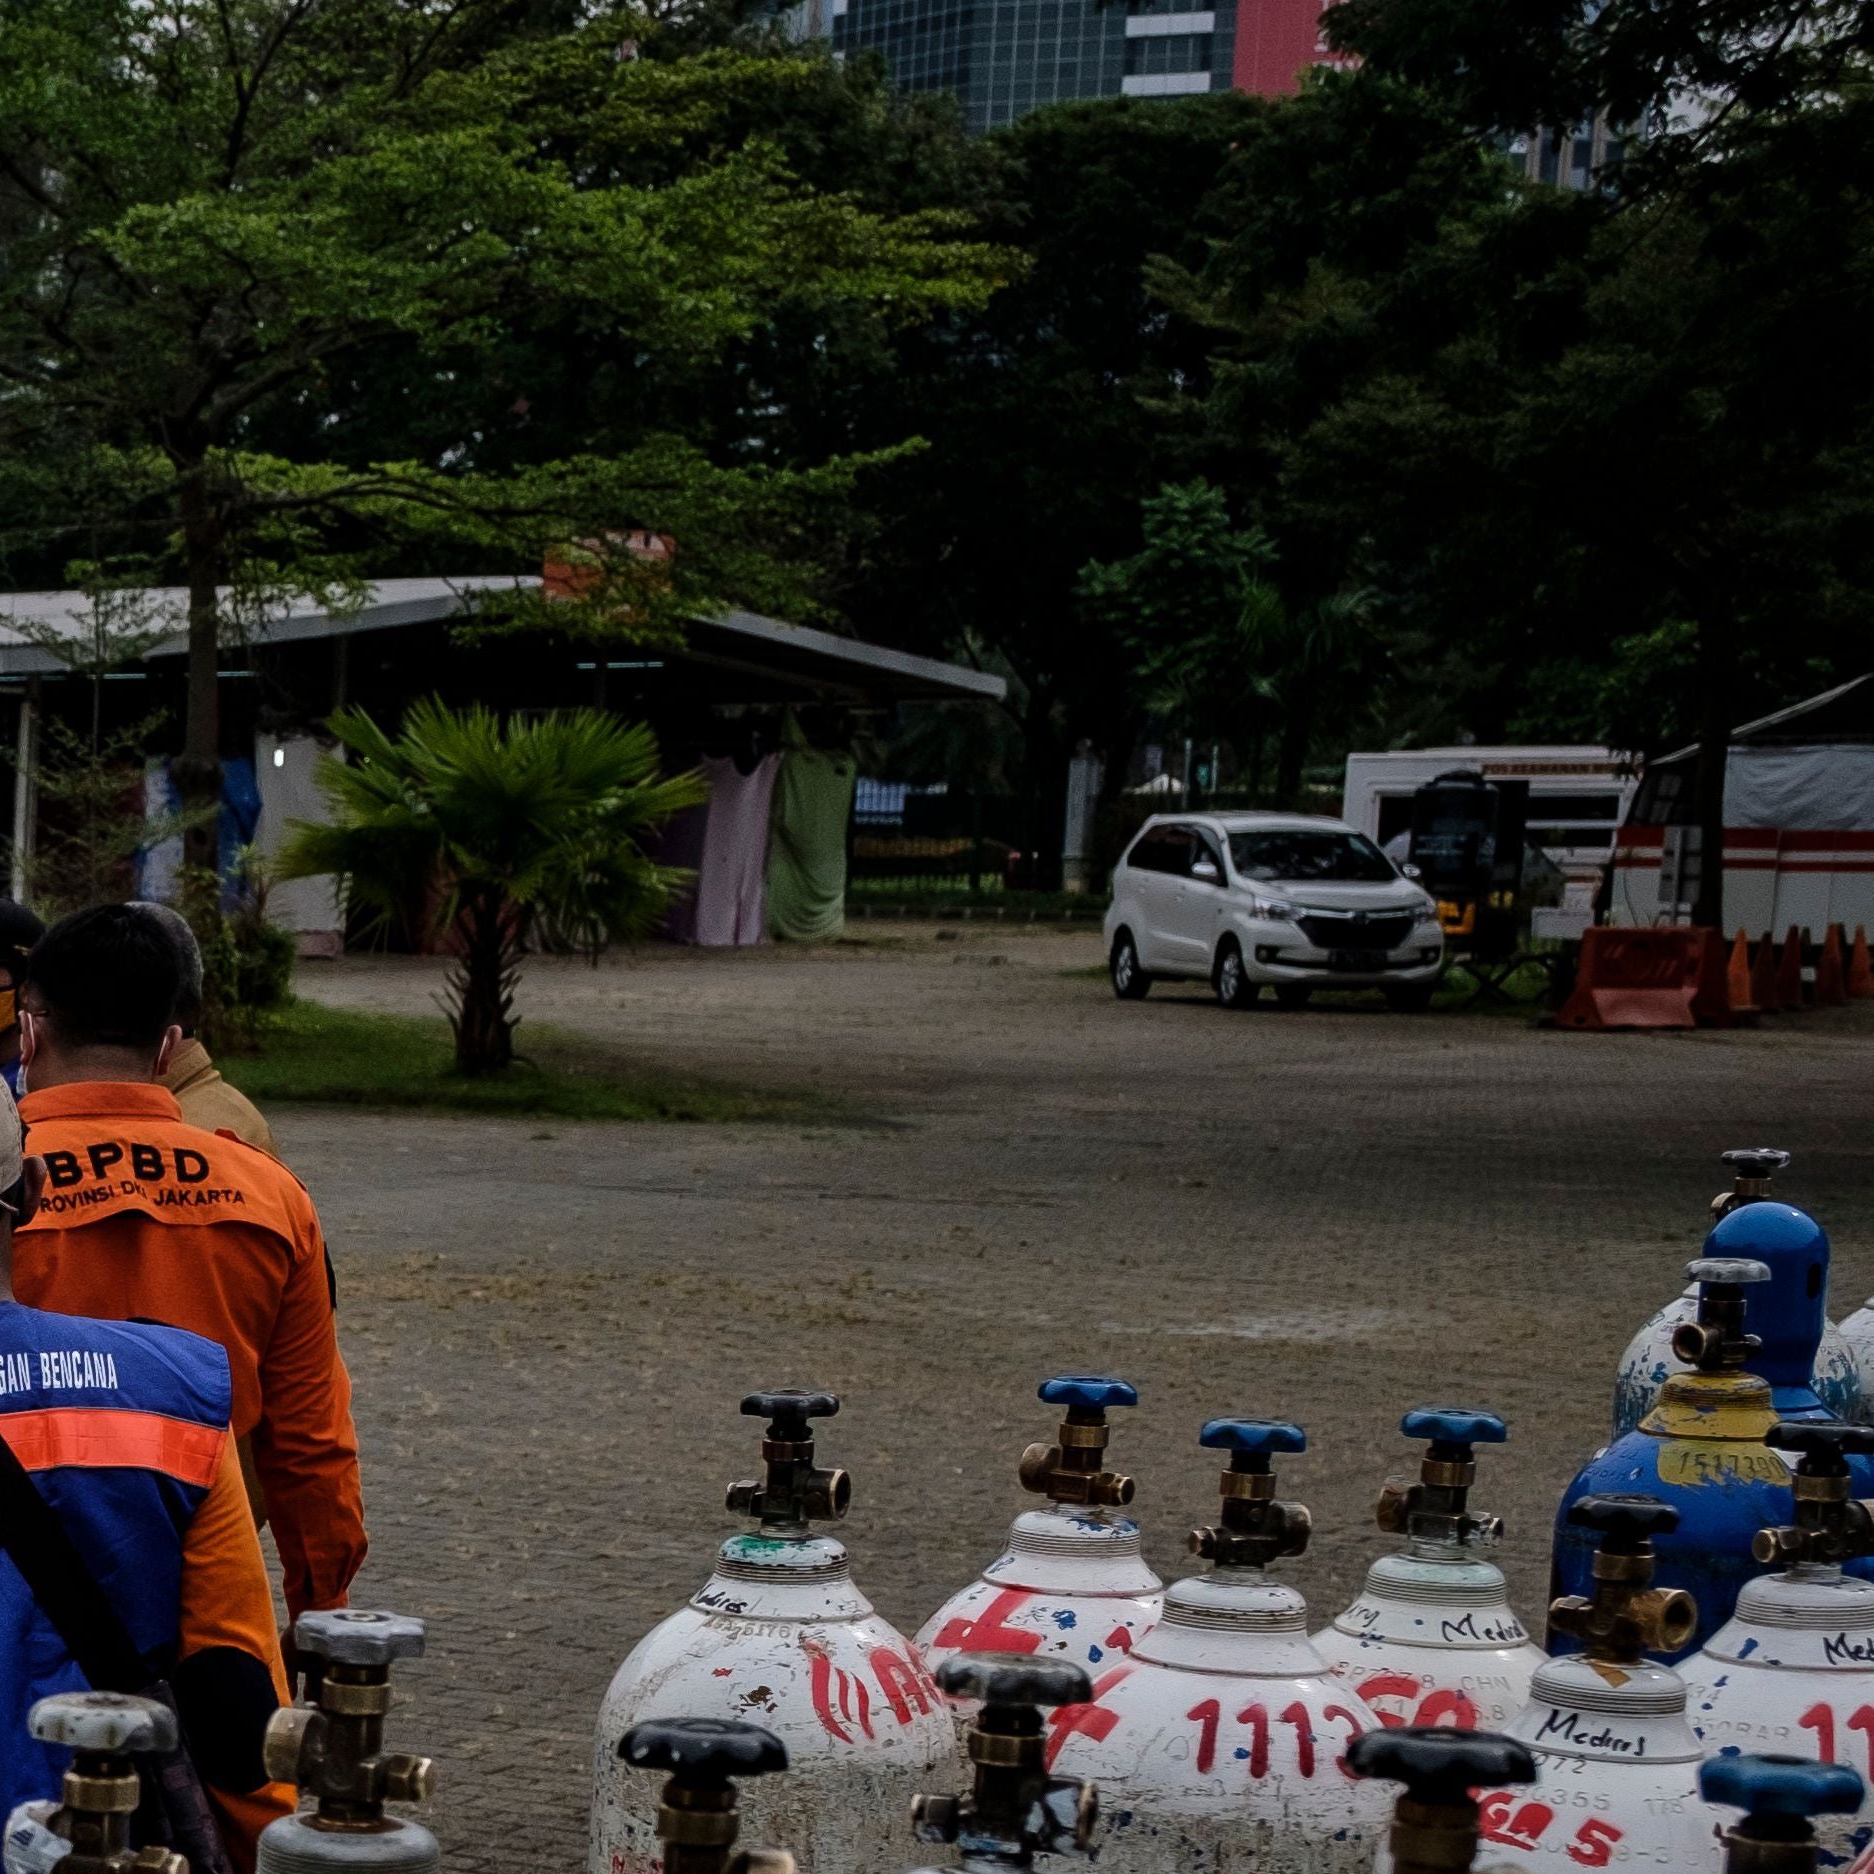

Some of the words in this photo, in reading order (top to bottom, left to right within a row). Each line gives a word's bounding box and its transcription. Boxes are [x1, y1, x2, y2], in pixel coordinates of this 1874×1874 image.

[44, 1140, 210, 1188] BPBD
[153, 1188, 245, 1207] JAKARTA
[40, 1350, 118, 1391] BENCANA
